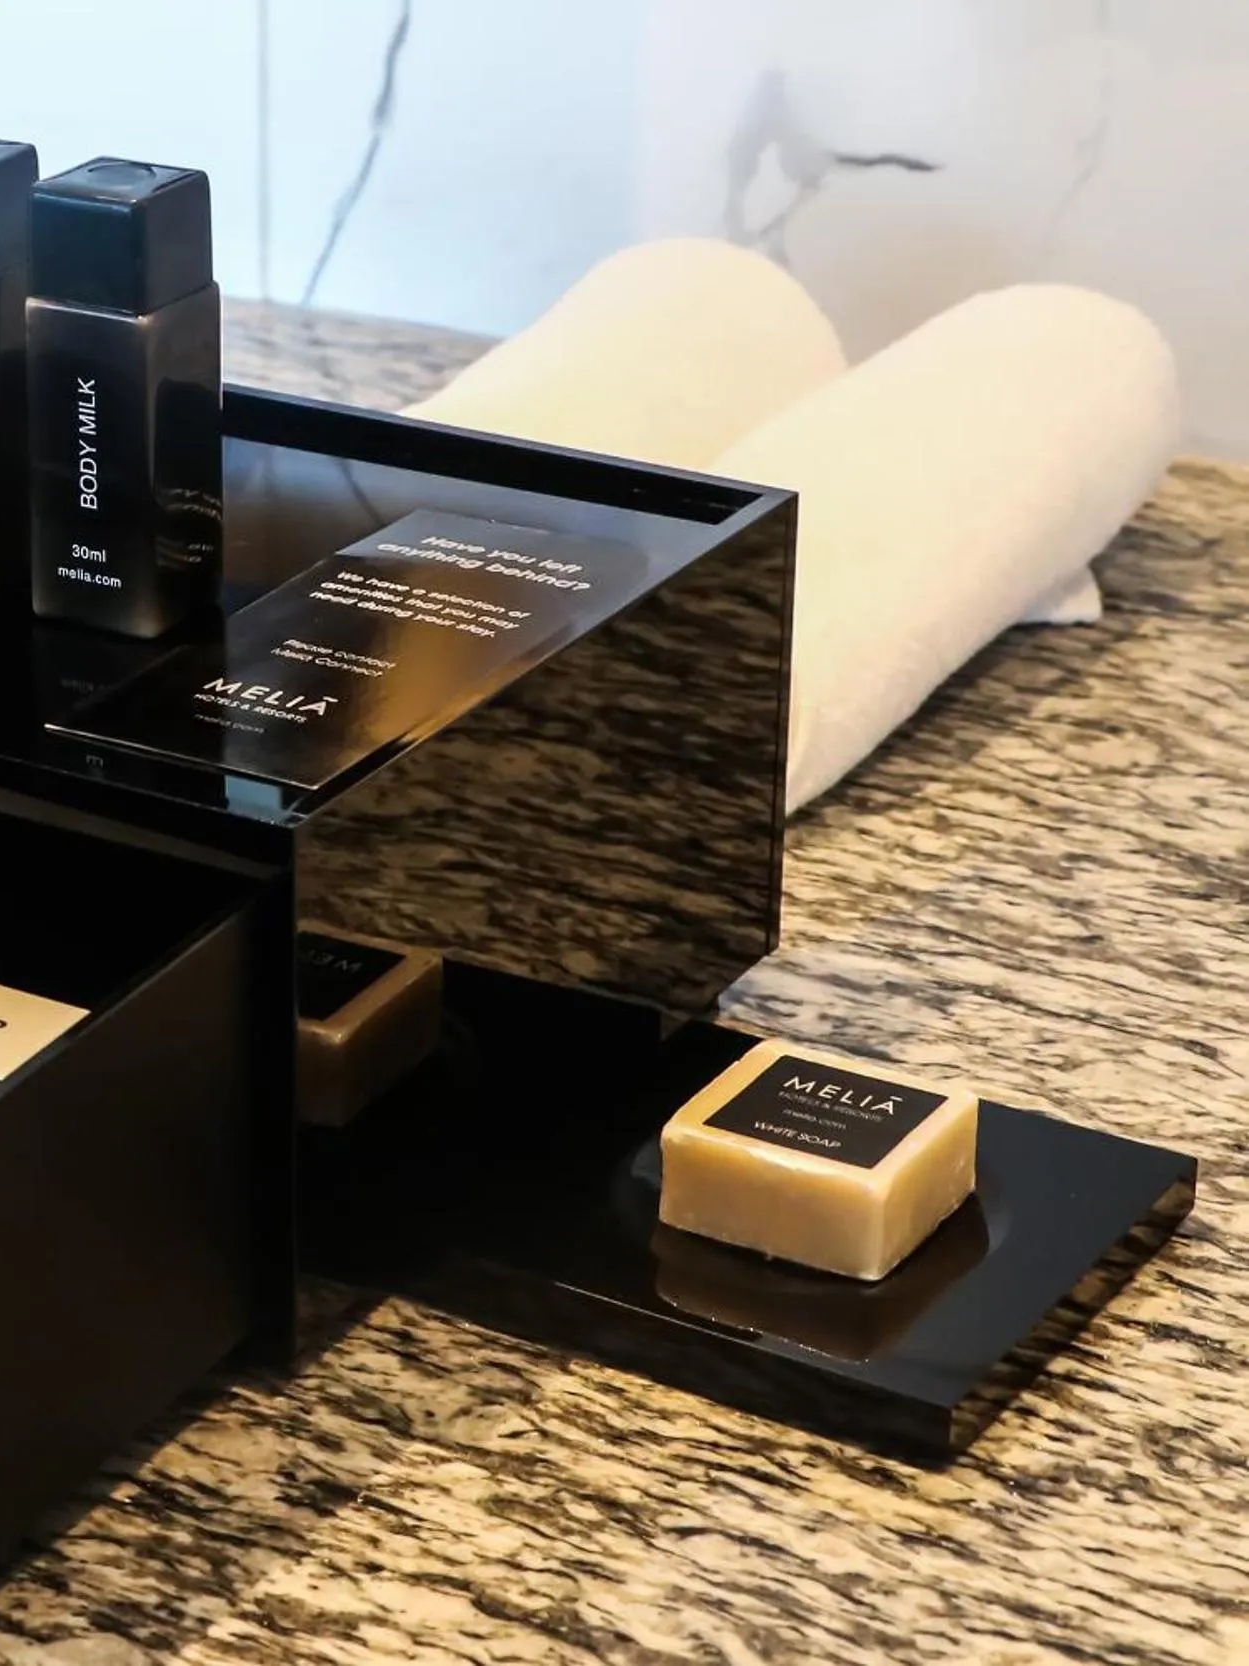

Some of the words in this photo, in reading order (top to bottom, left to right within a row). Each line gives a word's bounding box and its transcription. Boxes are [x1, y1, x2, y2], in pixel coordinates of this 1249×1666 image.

[77, 377, 97, 435] MILK
[79, 438, 97, 510] BODY
[71, 544, 107, 563] 30ml
[377, 543, 485, 570] anything
[485, 562, 591, 591] behind?
[420, 536, 486, 553] Have
[486, 549, 537, 565] you
[537, 559, 584, 574] left
[57, 565, 122, 588] melia.com
[337, 571, 365, 582] We
[365, 577, 410, 592] have
[428, 591, 505, 614] selection
[412, 613, 456, 627] your
[440, 607, 477, 620] you
[754, 1120, 798, 1138] WHITE
[797, 1132, 842, 1148] SOAP
